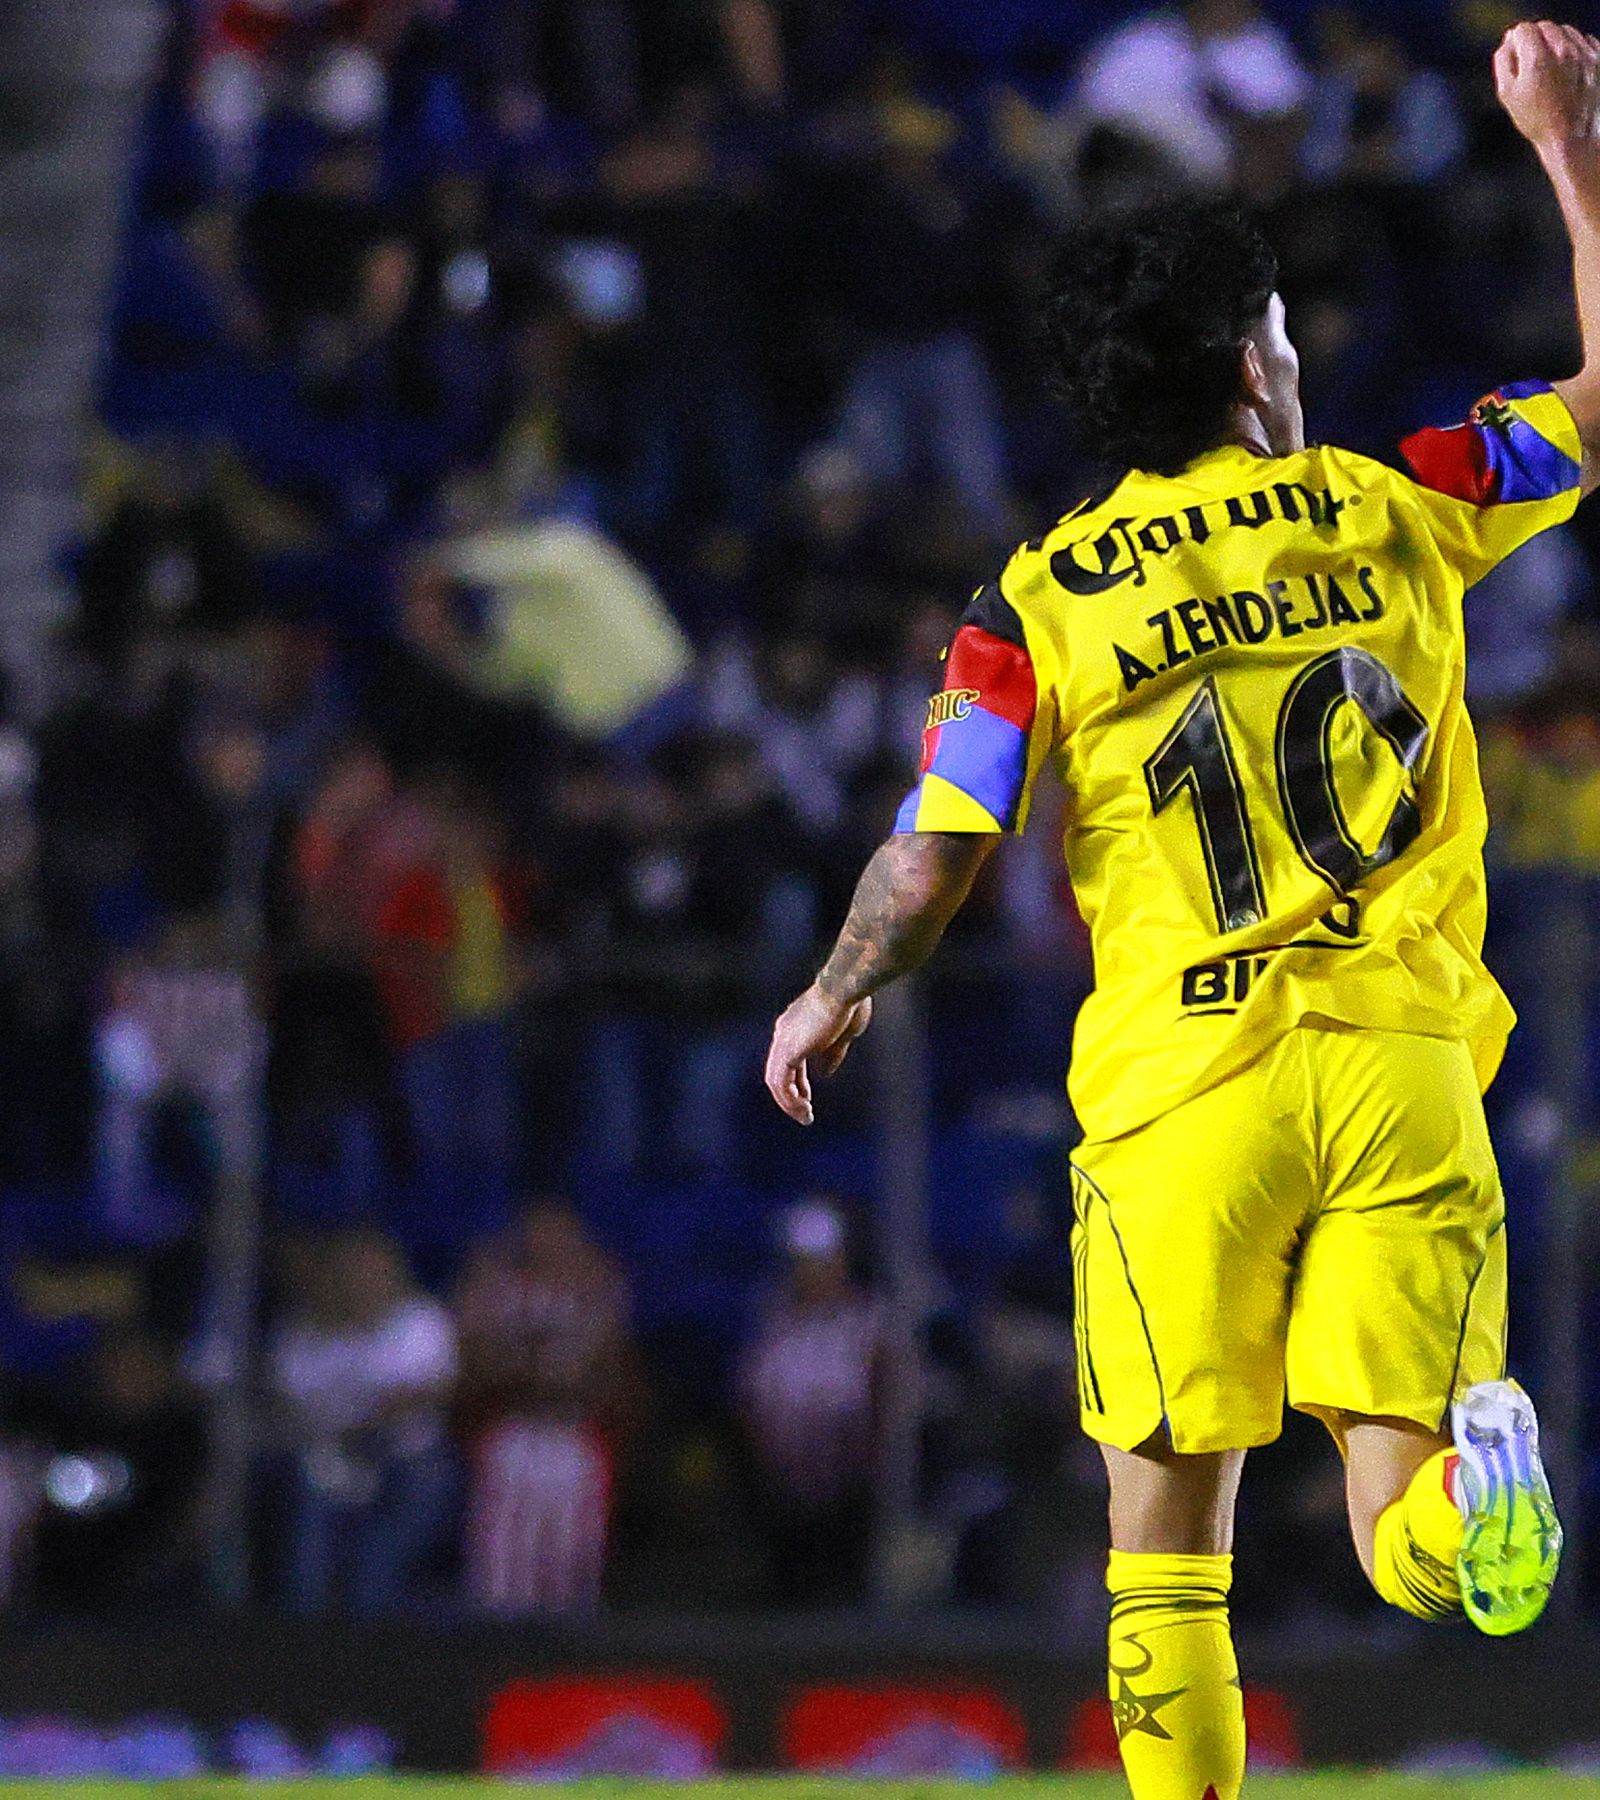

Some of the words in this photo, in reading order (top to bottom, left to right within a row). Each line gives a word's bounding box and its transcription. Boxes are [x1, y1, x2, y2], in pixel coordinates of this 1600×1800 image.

[1112, 566, 1385, 692] A.ZENDEJAS
[1142, 645, 1430, 938] 10
[1181, 958, 1269, 1005] BI
